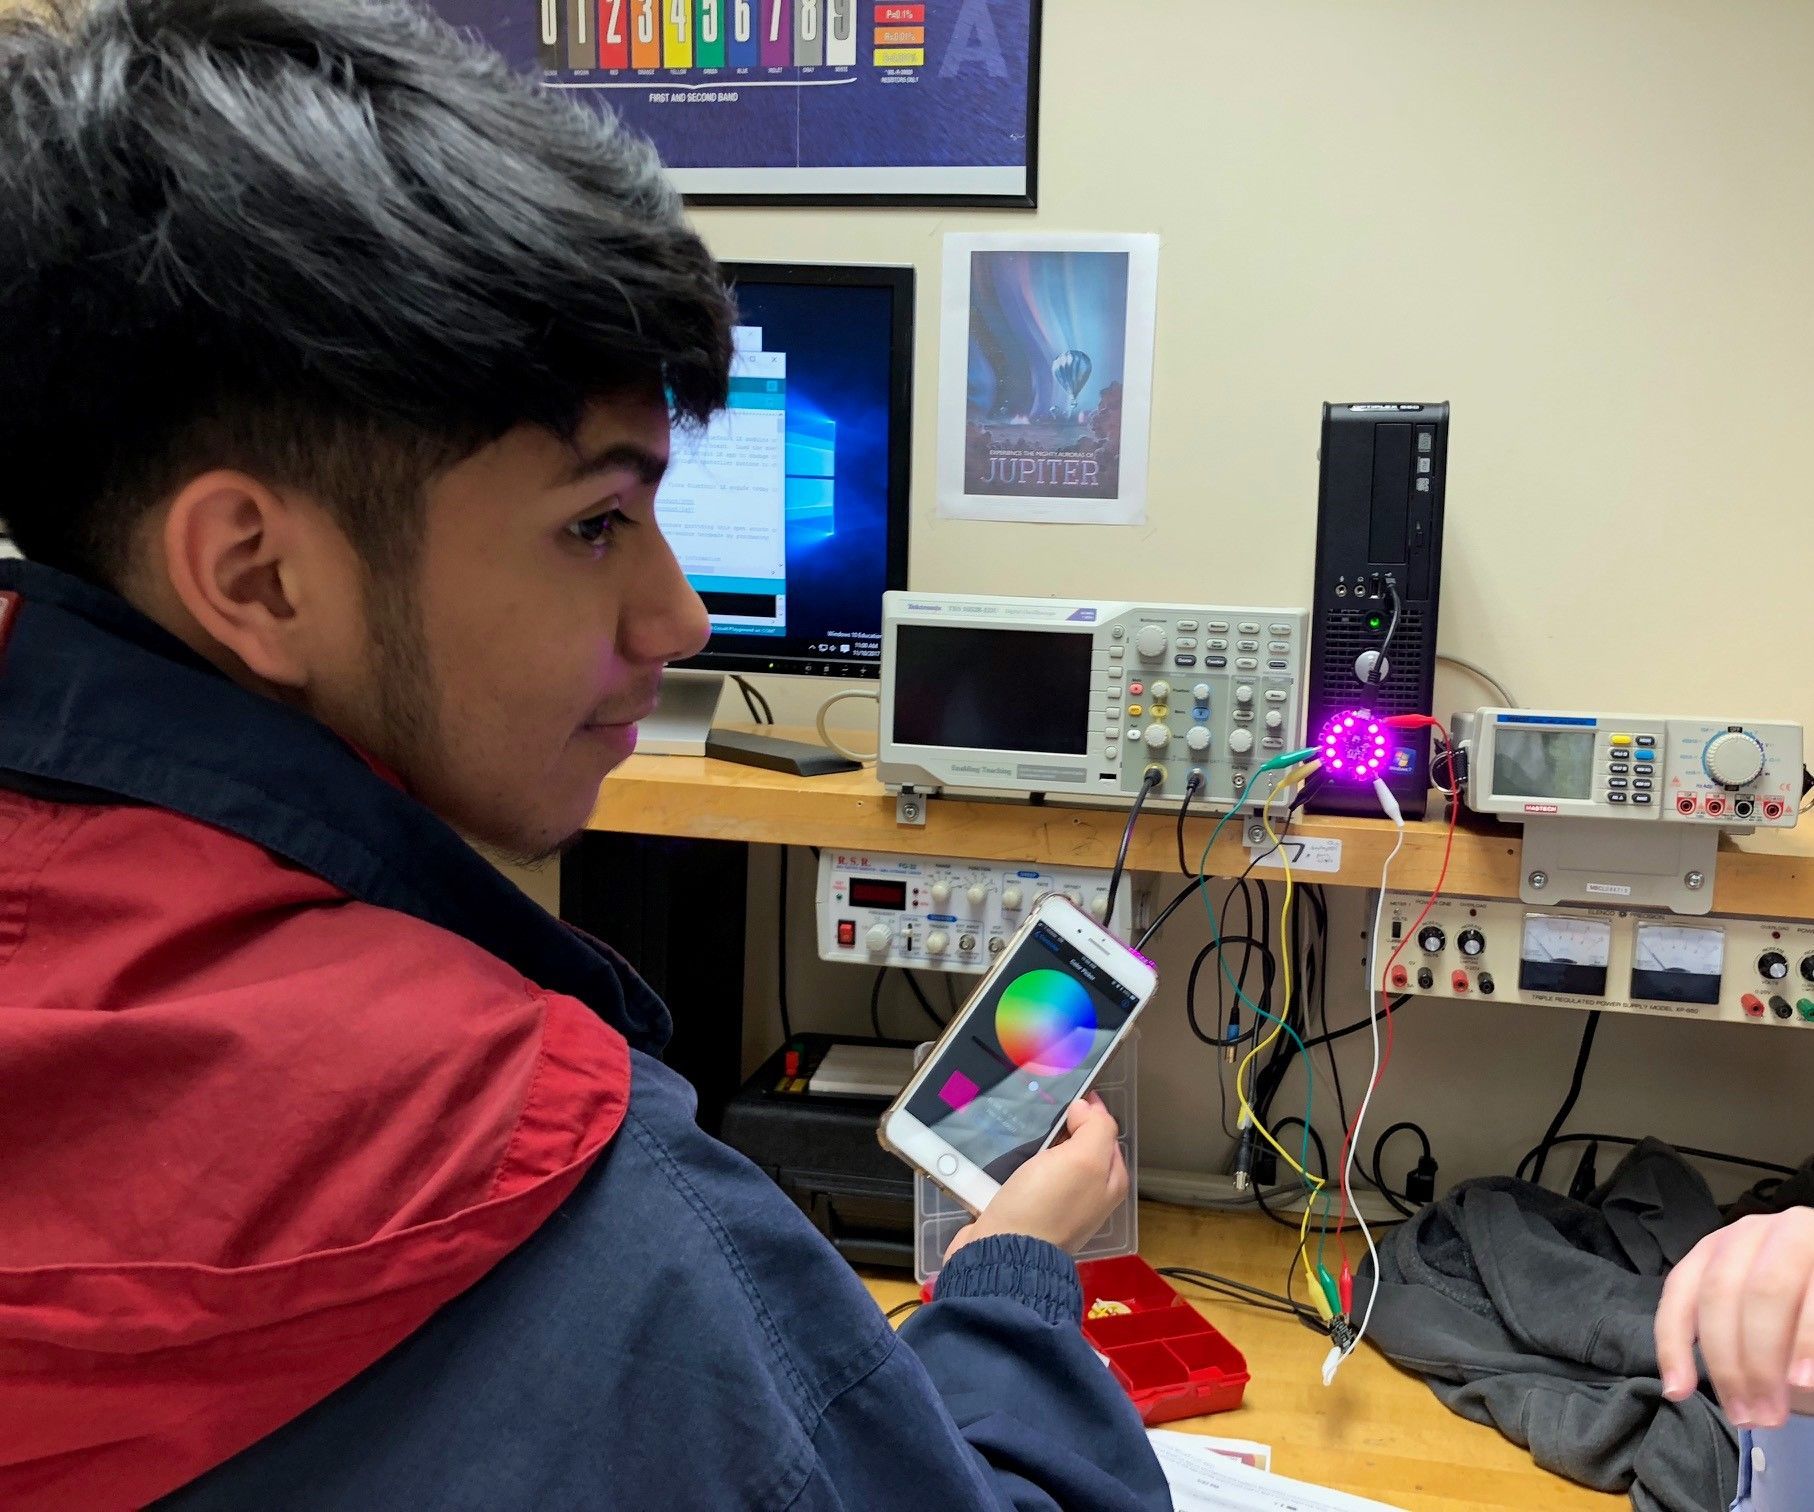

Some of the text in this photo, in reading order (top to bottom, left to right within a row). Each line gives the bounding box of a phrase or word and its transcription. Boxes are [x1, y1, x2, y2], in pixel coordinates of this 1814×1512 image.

[541, 0, 850, 44] 0 1 2 3 4 5 6 7 8 9
[649, 92, 739, 104] FIRST AND SECOND BAND
[989, 449, 1022, 457] EXPERIENCE
[980, 457, 1099, 486] JUPITER
[908, 603, 942, 612] Tektronix
[1525, 805, 1557, 813] MASTECH
[1588, 908, 1616, 916] ELENCO
[1532, 993, 1553, 1002] TRIPLE
[1554, 996, 1595, 1006] REGULATED
[1595, 999, 1623, 1008] POWER
[1622, 1001, 1649, 1010] SUPPLY
[1649, 1004, 1673, 1012] MODEL
